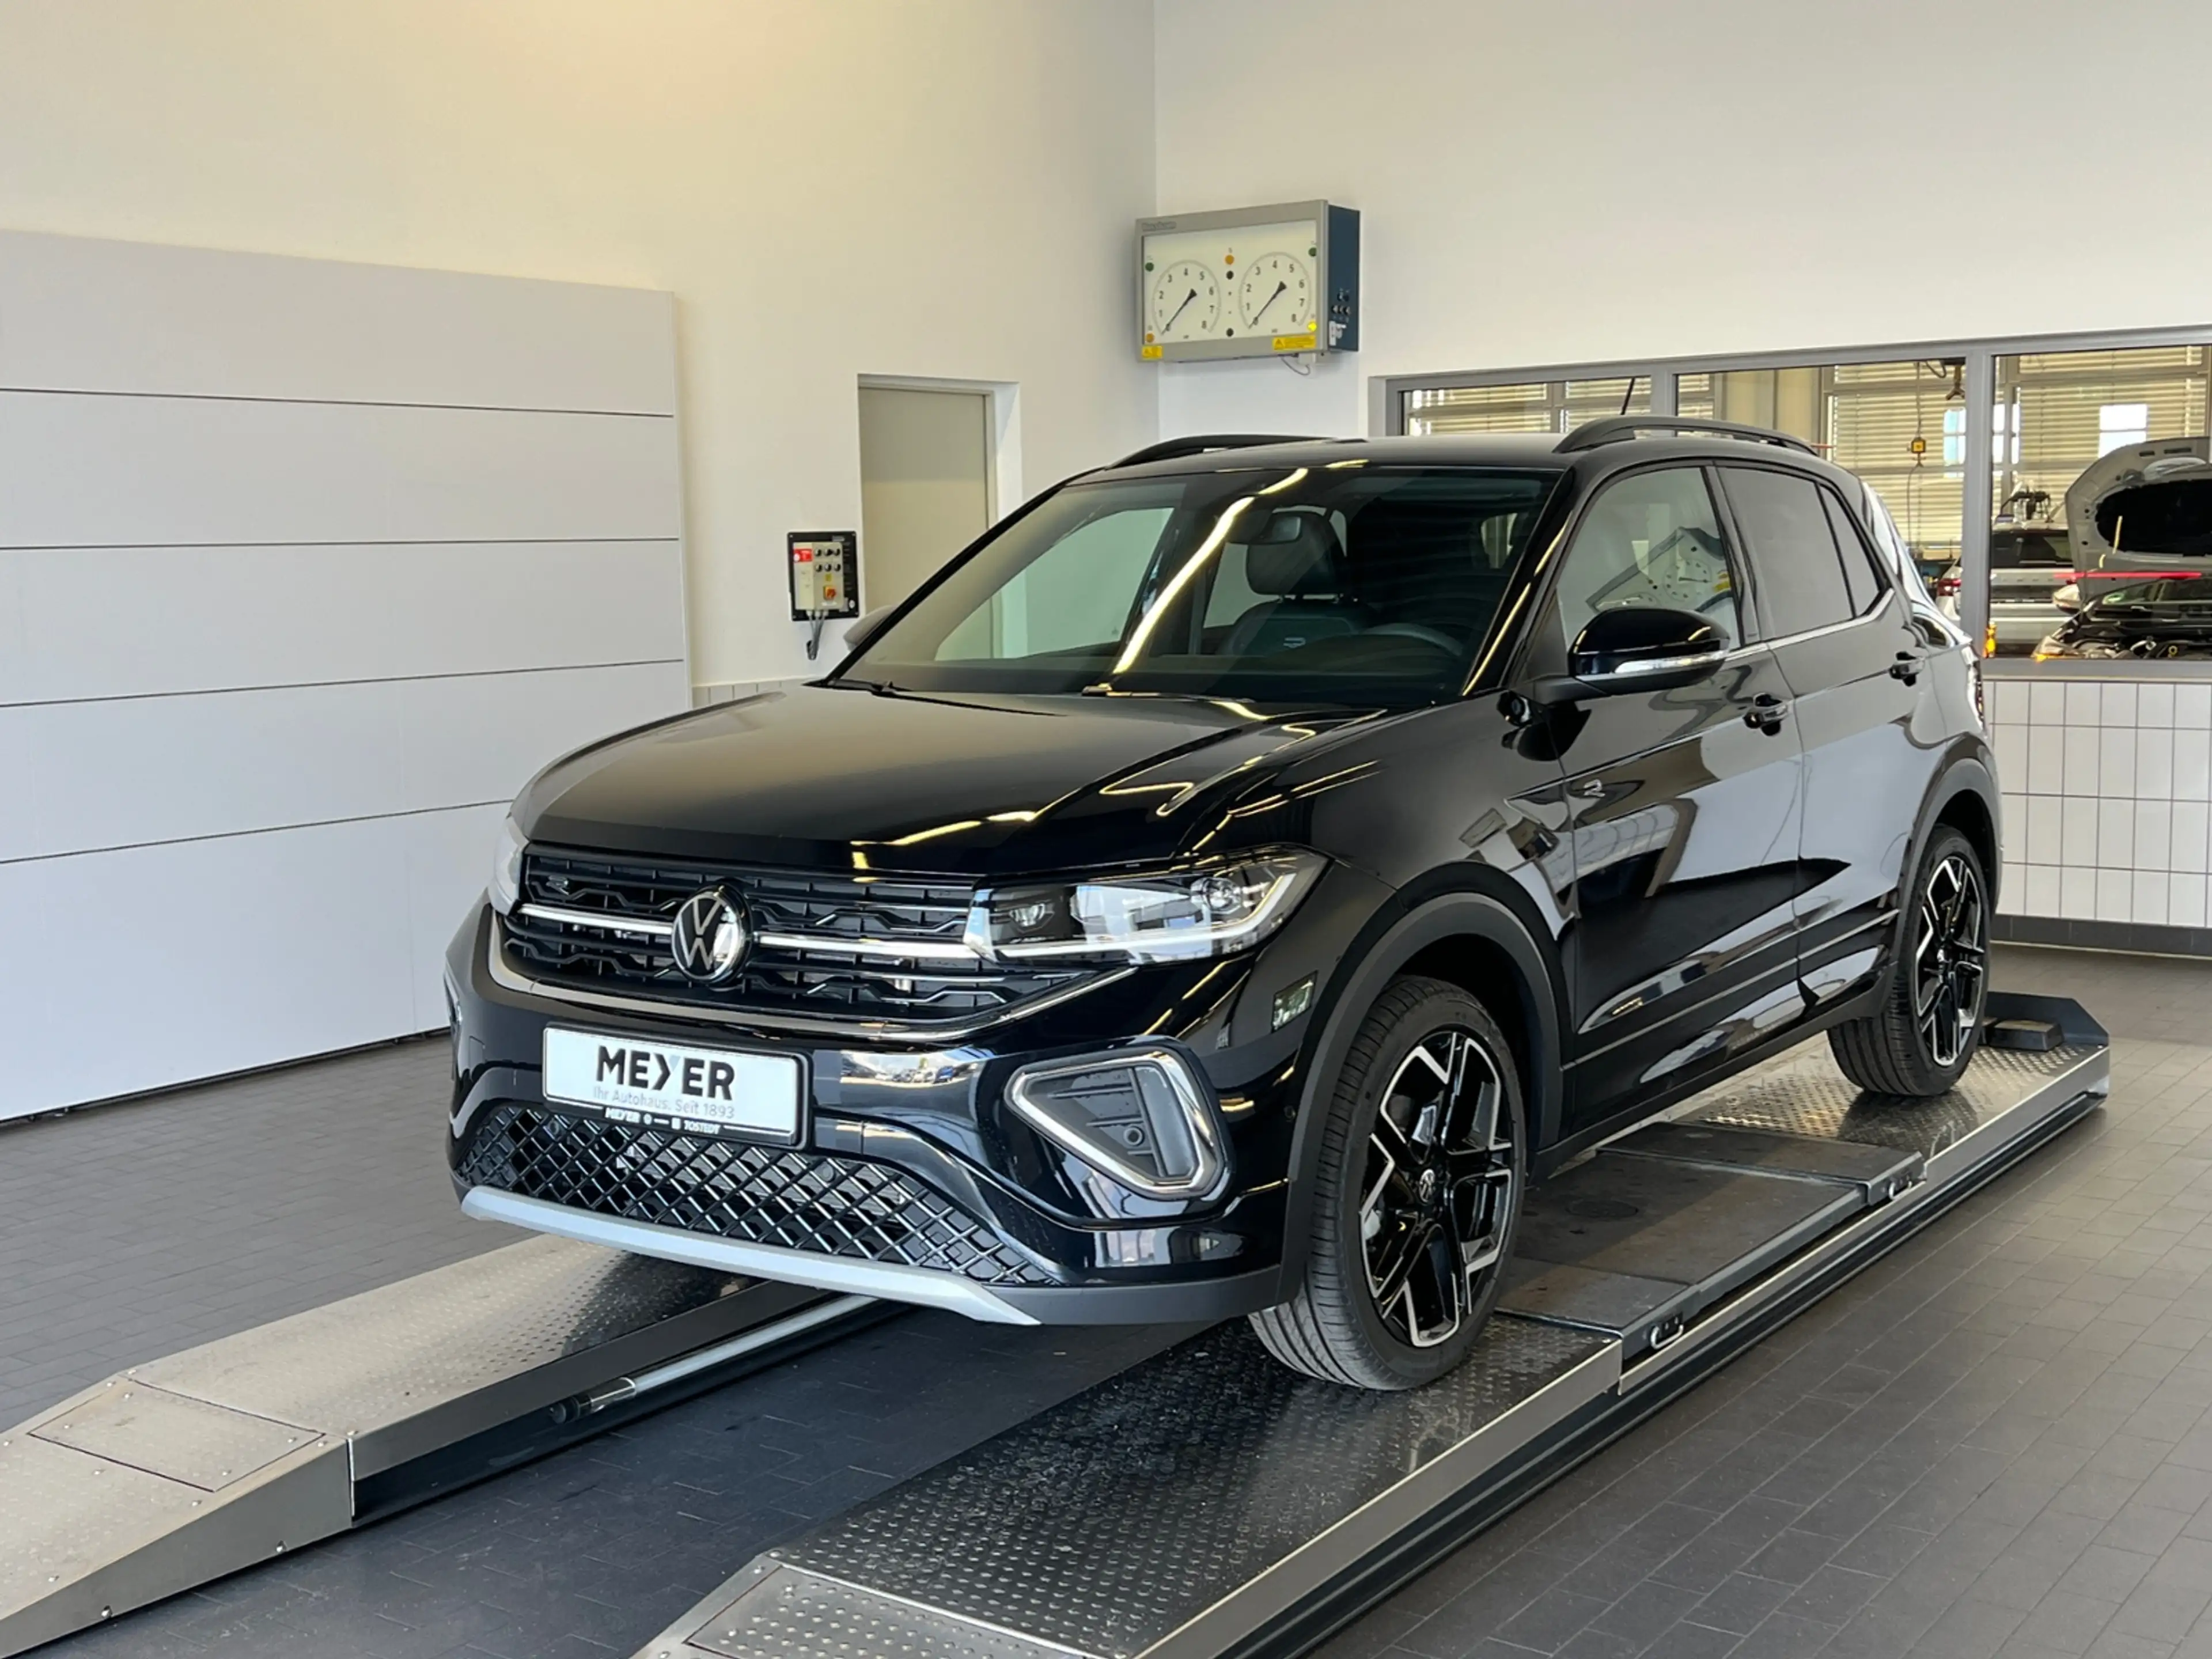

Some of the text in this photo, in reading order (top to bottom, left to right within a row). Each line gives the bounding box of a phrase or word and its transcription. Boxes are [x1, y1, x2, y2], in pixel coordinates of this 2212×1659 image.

[596, 1046, 735, 1101] MEYER
[594, 1086, 735, 1119] Ihr Autohaus. Seit 1893
